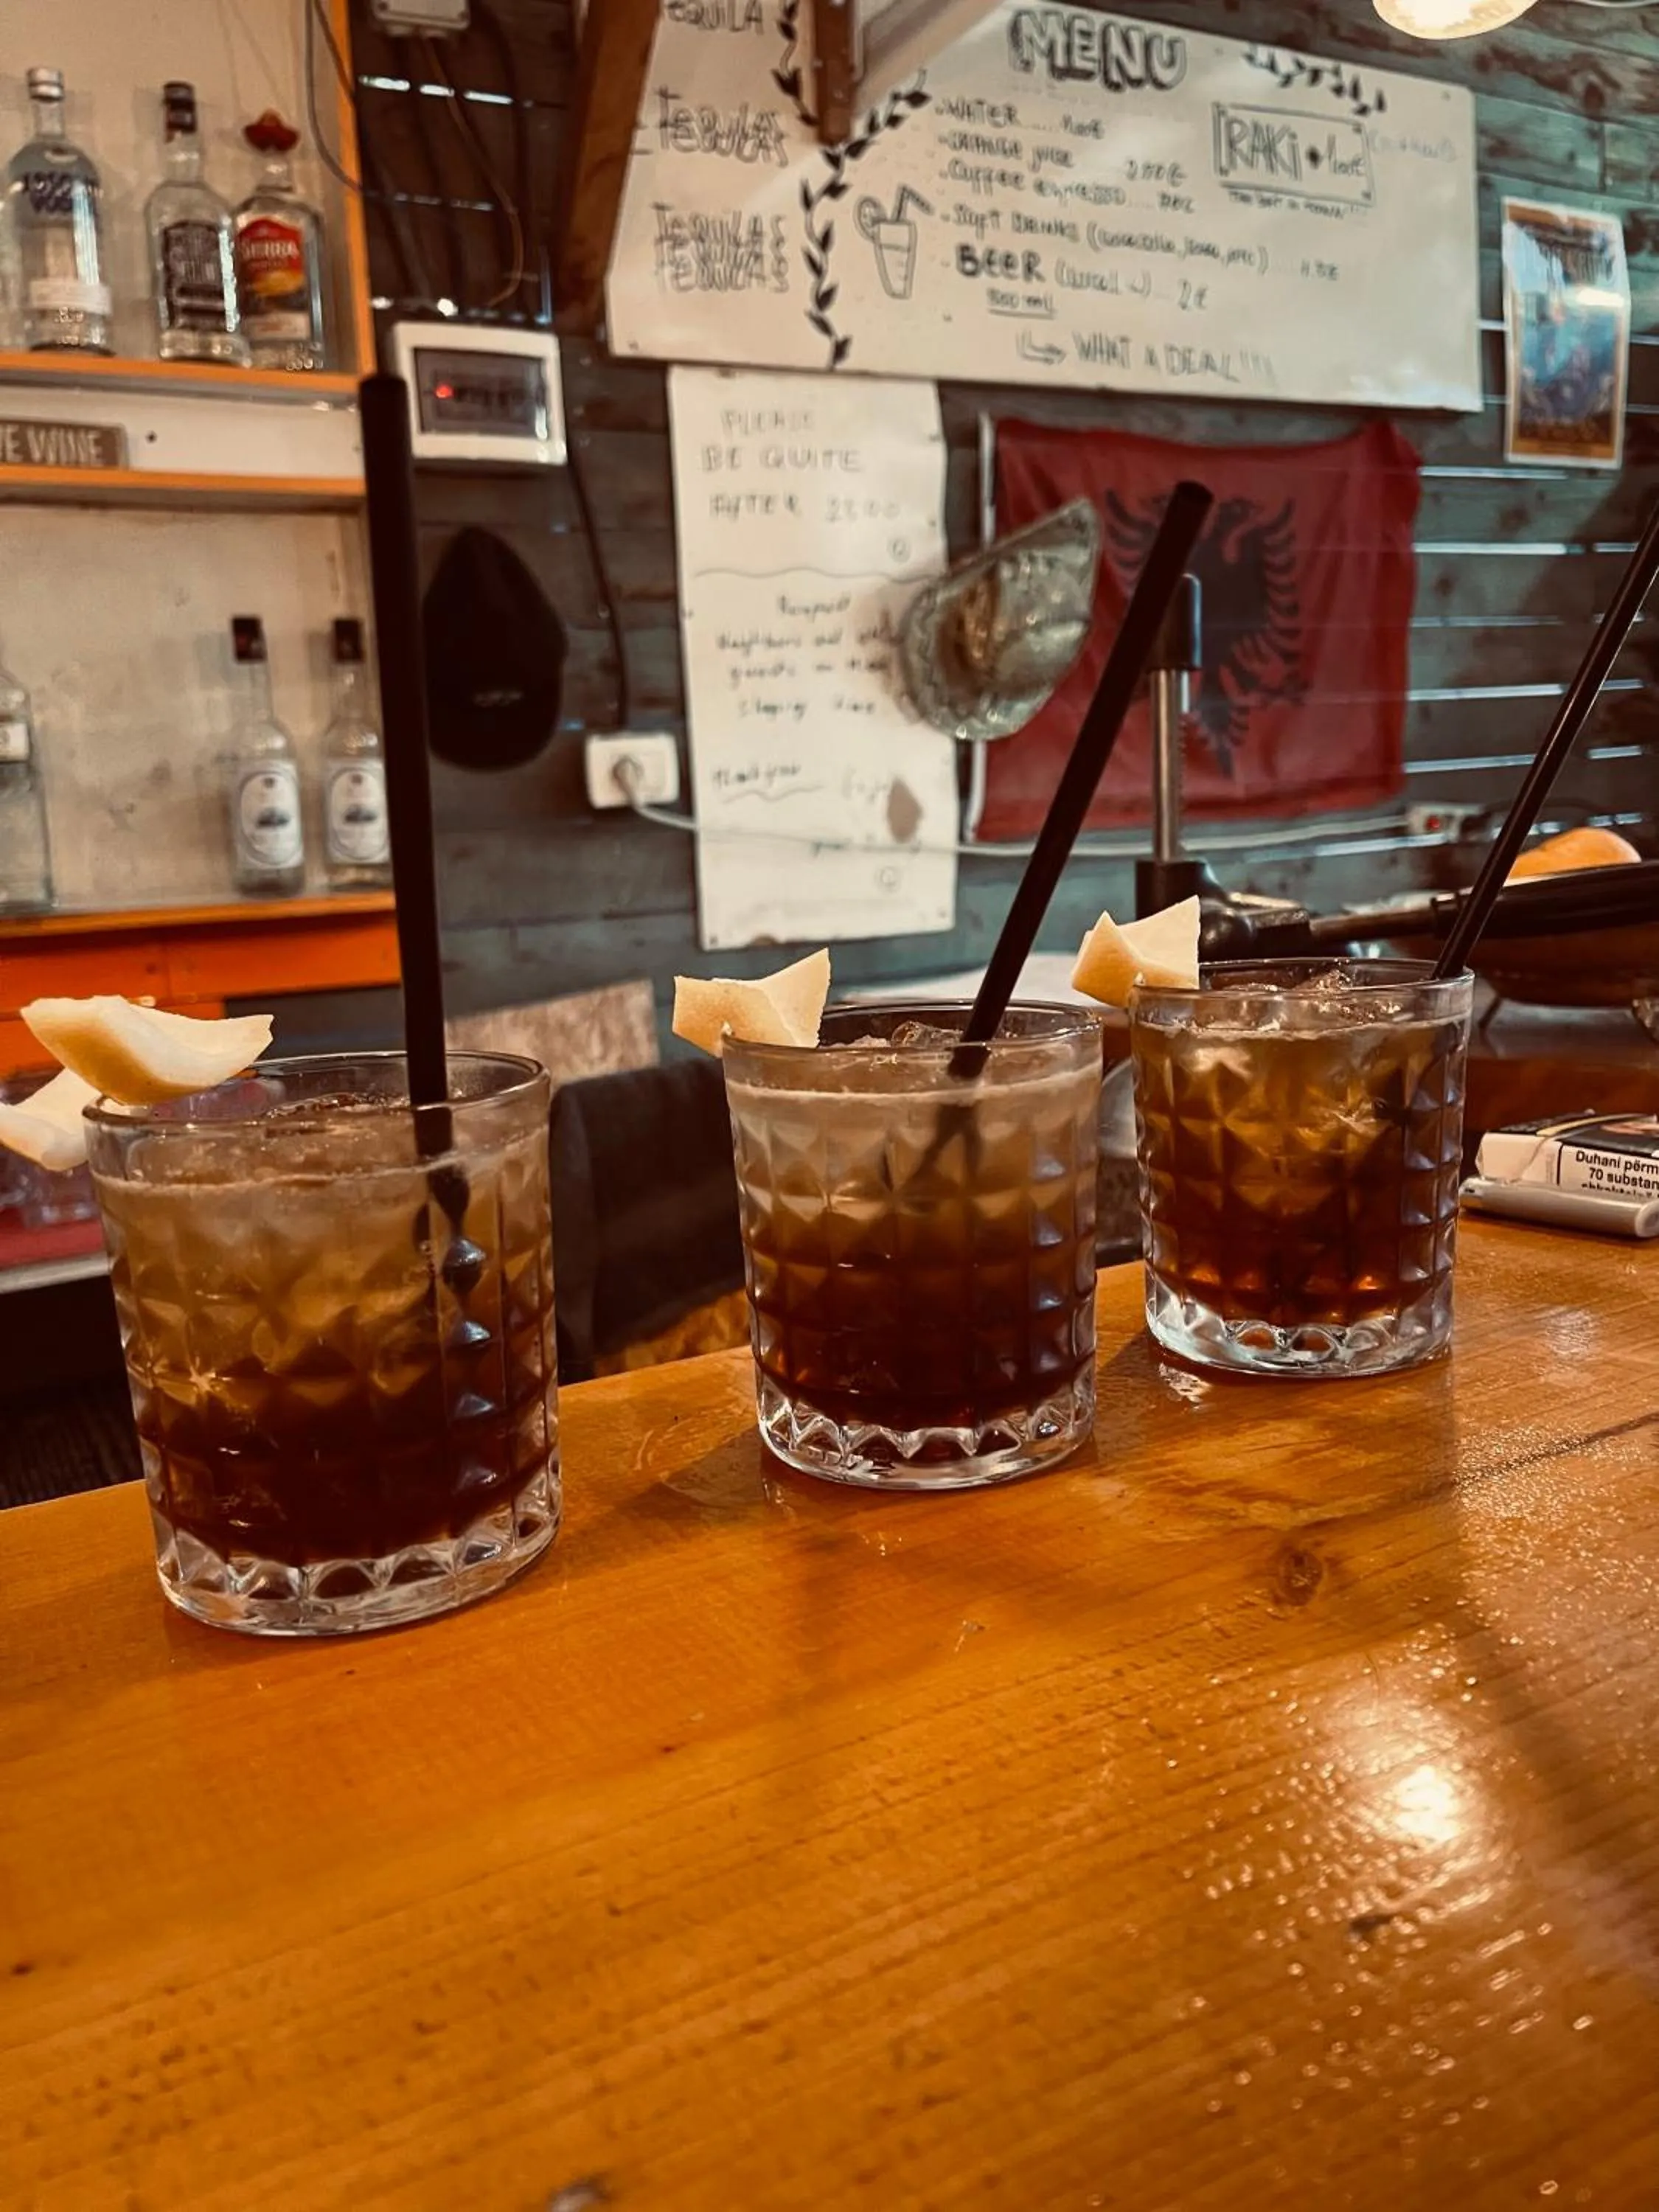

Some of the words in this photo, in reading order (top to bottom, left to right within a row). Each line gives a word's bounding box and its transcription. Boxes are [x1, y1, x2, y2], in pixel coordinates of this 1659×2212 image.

[1007, 8, 1187, 93] MENU
[1071, 330, 1133, 369] WHAT
[27, 425, 105, 469] WINE
[759, 445, 864, 474] QUITE
[1576, 1150, 1621, 1169] Duhani
[1589, 1166, 1604, 1180] 70
